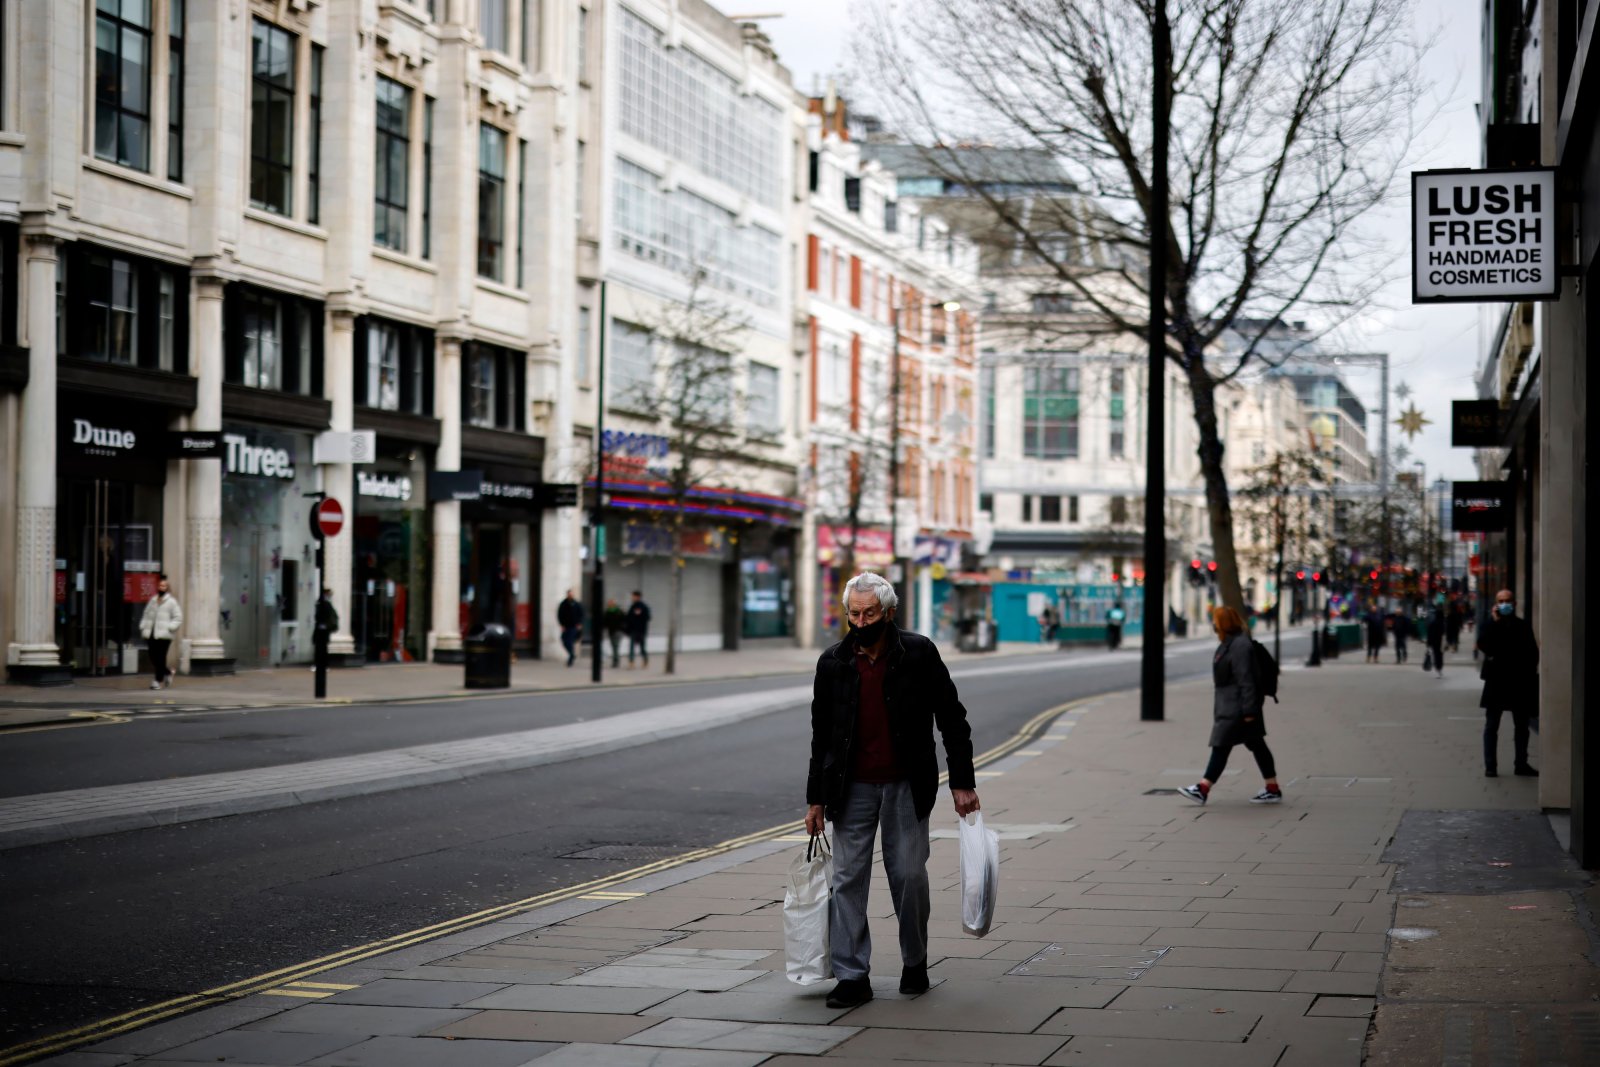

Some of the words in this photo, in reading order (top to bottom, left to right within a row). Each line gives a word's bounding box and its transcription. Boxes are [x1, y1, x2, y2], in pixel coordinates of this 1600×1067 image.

[1429, 184, 1541, 216] LUSH
[1429, 218, 1541, 246] FRESH
[1429, 249, 1541, 266] HANDMADE
[1429, 268, 1541, 285] COSMETICS
[73, 418, 136, 449] Dune
[223, 434, 294, 478] Three.
